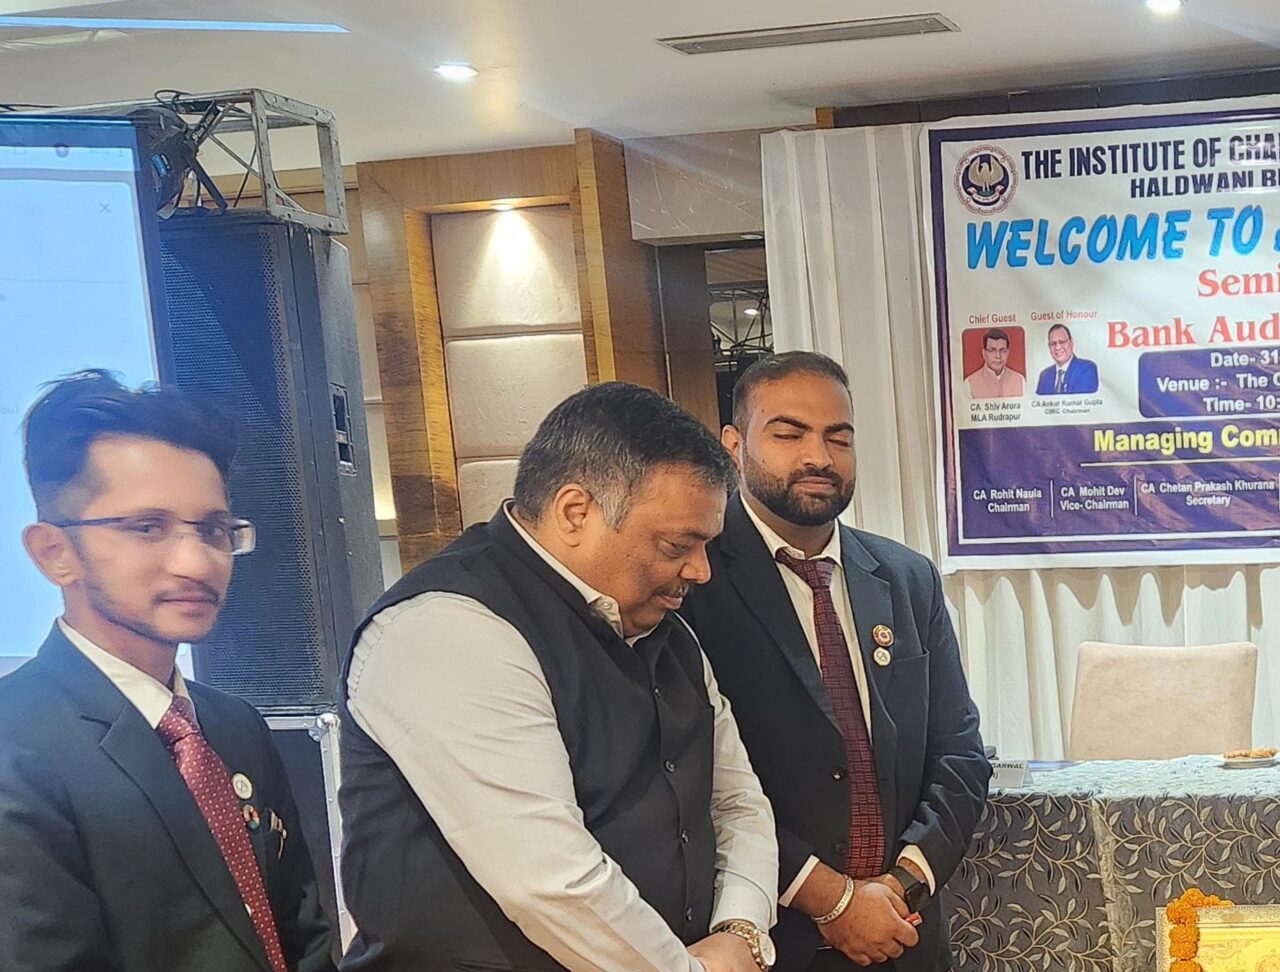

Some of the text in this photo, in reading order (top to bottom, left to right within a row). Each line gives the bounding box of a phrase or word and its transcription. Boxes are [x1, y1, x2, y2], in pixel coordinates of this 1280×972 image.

[1021, 149, 1062, 180] THE
[1069, 139, 1185, 177] INSTITUTE
[1193, 137, 1221, 168] OF
[1131, 170, 1254, 198] HALDWANI
[967, 209, 1192, 270] WELCOME
[1207, 204, 1264, 257] TO
[969, 313, 1016, 324] Chief Guest
[1030, 310, 1098, 321] Guest of Honour
[1106, 314, 1197, 349] Bank
[1210, 351, 1256, 368] Date-
[1156, 376, 1210, 393] Venue
[1236, 373, 1268, 388] The
[970, 402, 1021, 412] CA Shiv Arora
[1203, 396, 1252, 413] Time-
[971, 413, 1021, 423] MLA Rudrapur
[1093, 427, 1213, 456] Managing
[1061, 485, 1125, 497] CA Mohit Dev
[1141, 480, 1275, 494] CA Chetan Prakash Khurana
[973, 490, 986, 500] CA
[990, 489, 1014, 499] Rohit
[987, 502, 1030, 513] Chairman
[1060, 499, 1129, 511] Vice- Chairman
[1186, 495, 1232, 508] Secretary
